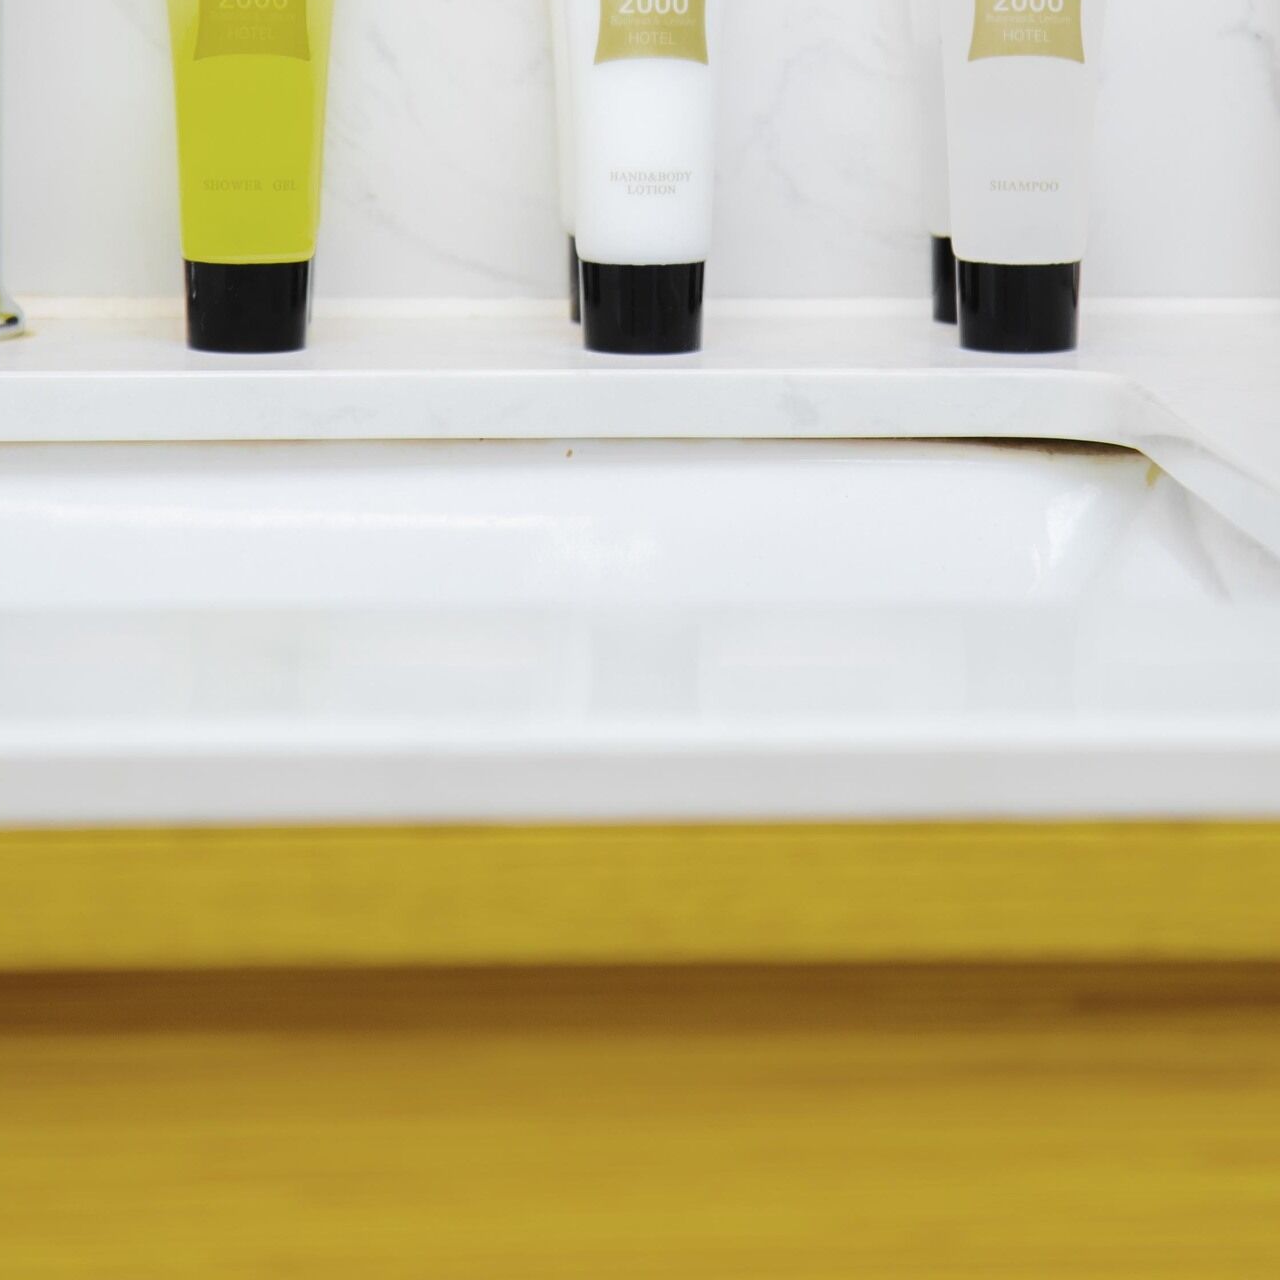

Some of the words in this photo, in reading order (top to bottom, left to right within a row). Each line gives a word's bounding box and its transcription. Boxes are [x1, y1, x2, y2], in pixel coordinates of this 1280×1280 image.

[628, 31, 677, 45] HOTEL
[1003, 29, 1051, 42] HOTEL
[609, 170, 693, 183] HAND&BODY
[202, 179, 263, 192] SHOWER
[272, 179, 297, 192] GEL
[627, 184, 677, 195] LOTION
[990, 179, 1061, 192] SHAMPOO
